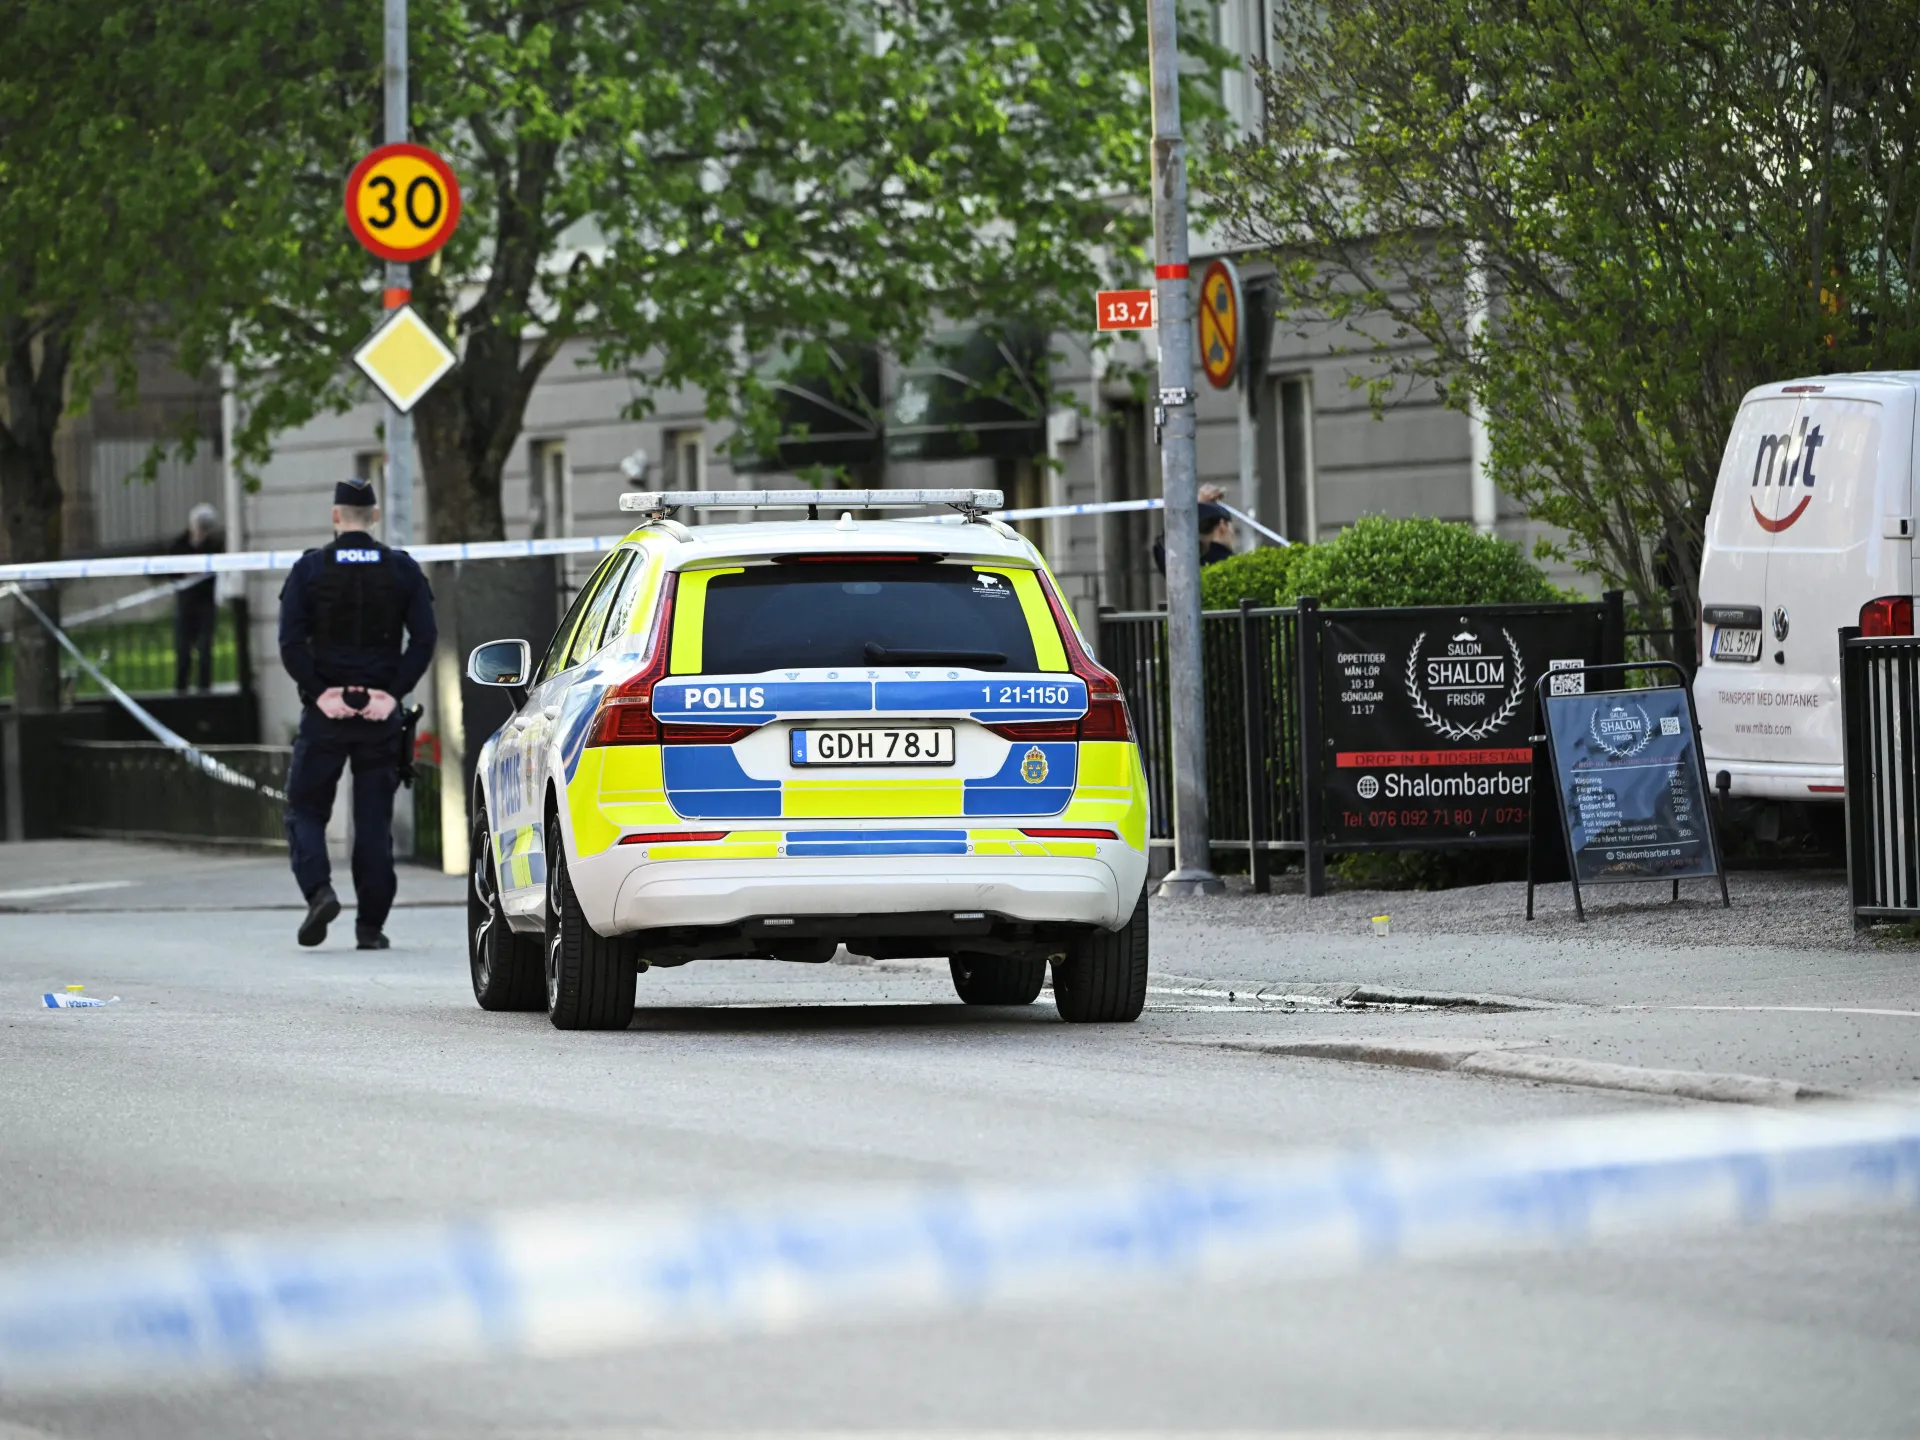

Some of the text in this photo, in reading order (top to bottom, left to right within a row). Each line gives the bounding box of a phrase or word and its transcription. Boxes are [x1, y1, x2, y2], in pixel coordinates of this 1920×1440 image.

[368, 175, 442, 230] 30
[1107, 301, 1149, 324] 13,7
[1752, 416, 1824, 487] mlt
[336, 549, 380, 562] POLIS
[1717, 630, 1758, 654] NSL 59M
[1447, 643, 1482, 656] SALON
[1337, 652, 1386, 664] ÖPPETTIDER
[784, 670, 960, 681] VOLVO
[1344, 665, 1380, 676] MÅN-LÖR
[1427, 662, 1505, 685] SHALOM
[1351, 679, 1375, 689] 10-19
[684, 687, 765, 709] POLIS
[982, 686, 1069, 705] 1 21-1150
[1341, 690, 1384, 702] SÖNDAGAR
[1446, 692, 1486, 706] FRISÖR
[1718, 691, 1819, 708] TRANSPORT MED OMTANKE
[1351, 704, 1375, 715] 11-17
[1610, 711, 1628, 719] SALON
[1600, 720, 1641, 733] SHALOM
[1734, 721, 1792, 736] www.mltab.com
[818, 732, 940, 759] GDH 78J
[1355, 754, 1396, 766] DROP
[1401, 754, 1414, 765] IN
[1419, 753, 1430, 764] &
[1385, 771, 1532, 798] Shalombarber
[1580, 803, 1601, 811] Endast
[1369, 811, 1397, 827] 076
[1401, 810, 1428, 826] 092
[1433, 810, 1449, 825] 71
[1454, 809, 1473, 824] 80
[1616, 848, 1681, 860] Shalombarber.se
